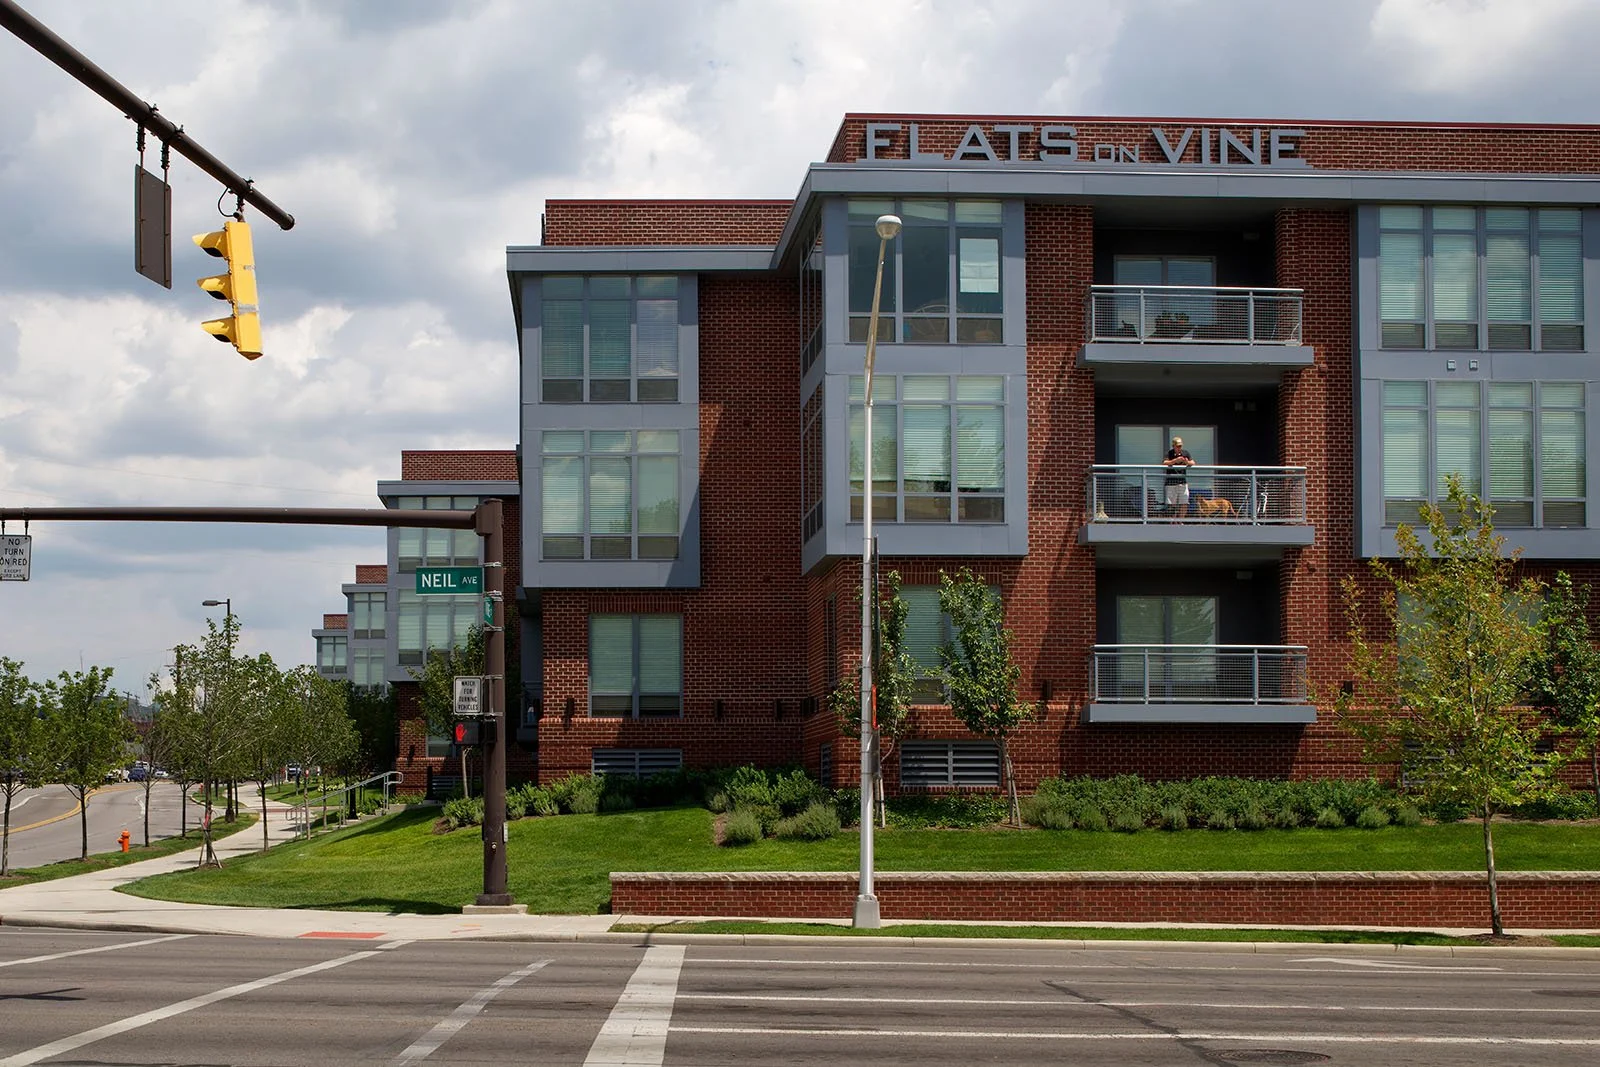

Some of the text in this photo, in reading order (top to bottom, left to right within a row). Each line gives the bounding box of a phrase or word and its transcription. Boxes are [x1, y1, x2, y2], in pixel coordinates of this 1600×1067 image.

[866, 122, 1307, 166] FLATS ON VINE
[8, 538, 21, 546] NO
[4, 548, 24, 556] TURN
[13, 558, 28, 566] RED
[421, 573, 478, 588] NEIL AVE
